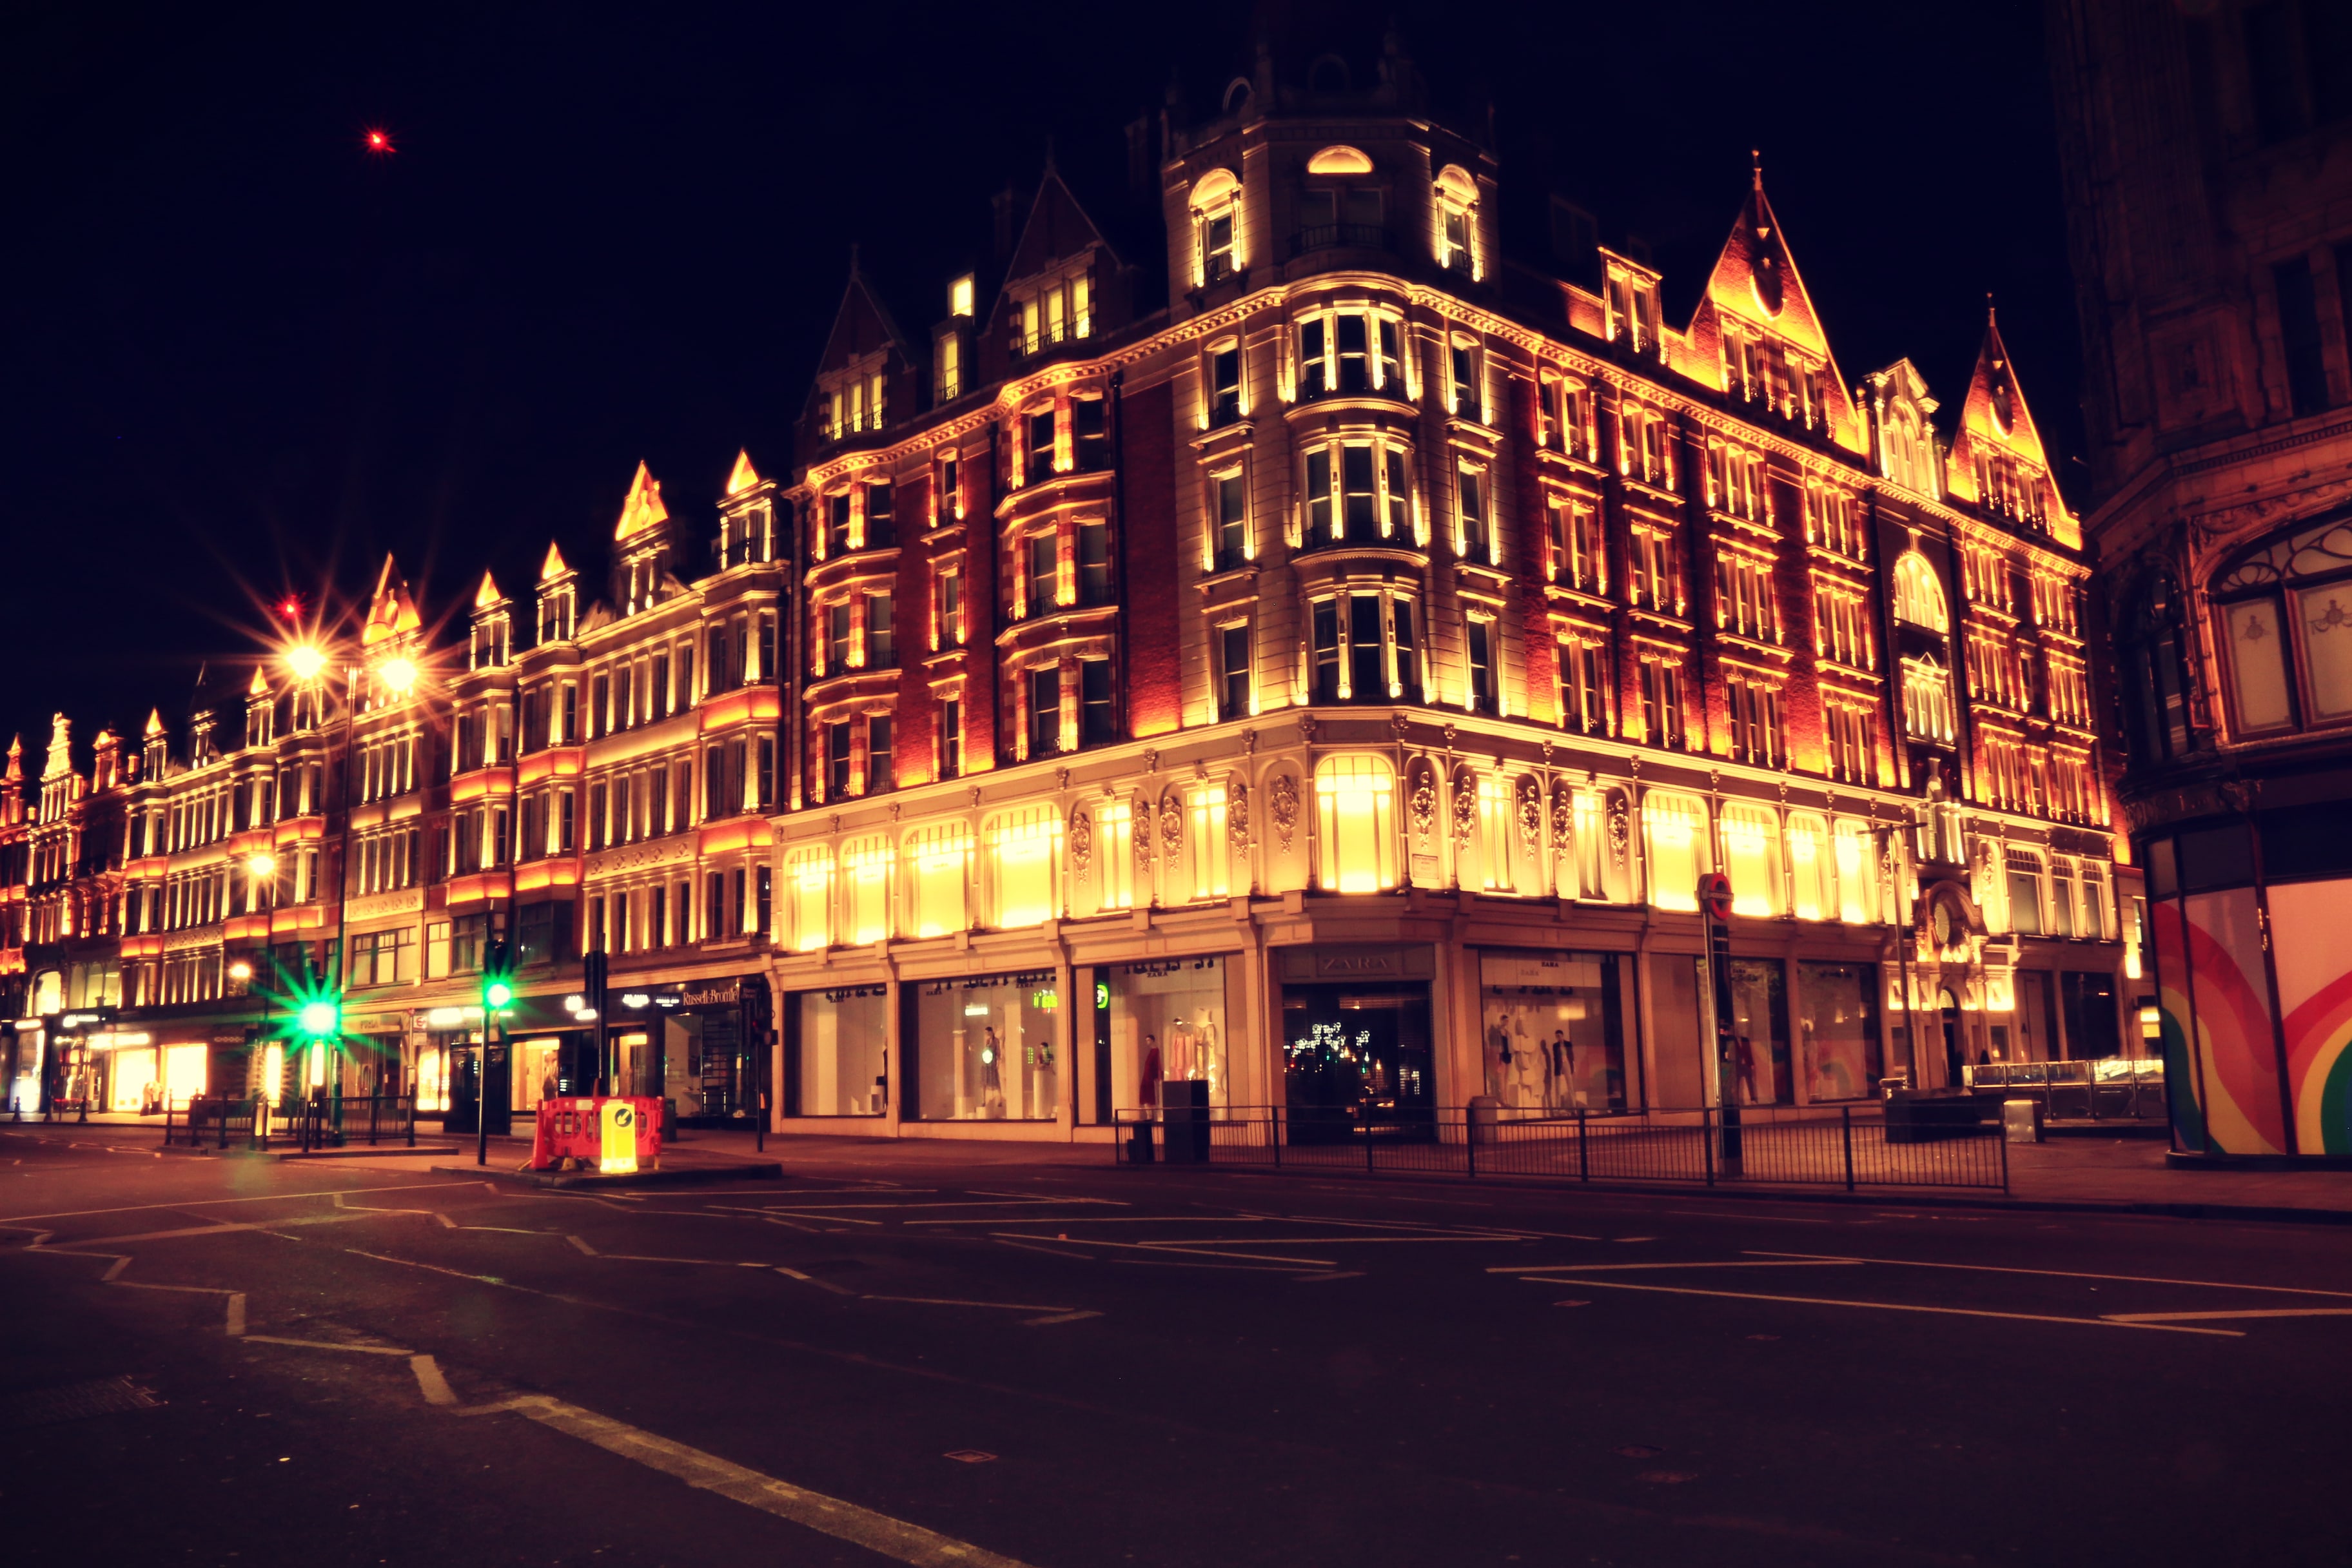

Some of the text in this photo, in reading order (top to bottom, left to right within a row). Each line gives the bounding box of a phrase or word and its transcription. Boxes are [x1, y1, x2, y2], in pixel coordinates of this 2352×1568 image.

[1323, 958, 1389, 970] ZARA
[683, 990, 708, 1006] Russell
[711, 988, 739, 1003] Bromle
